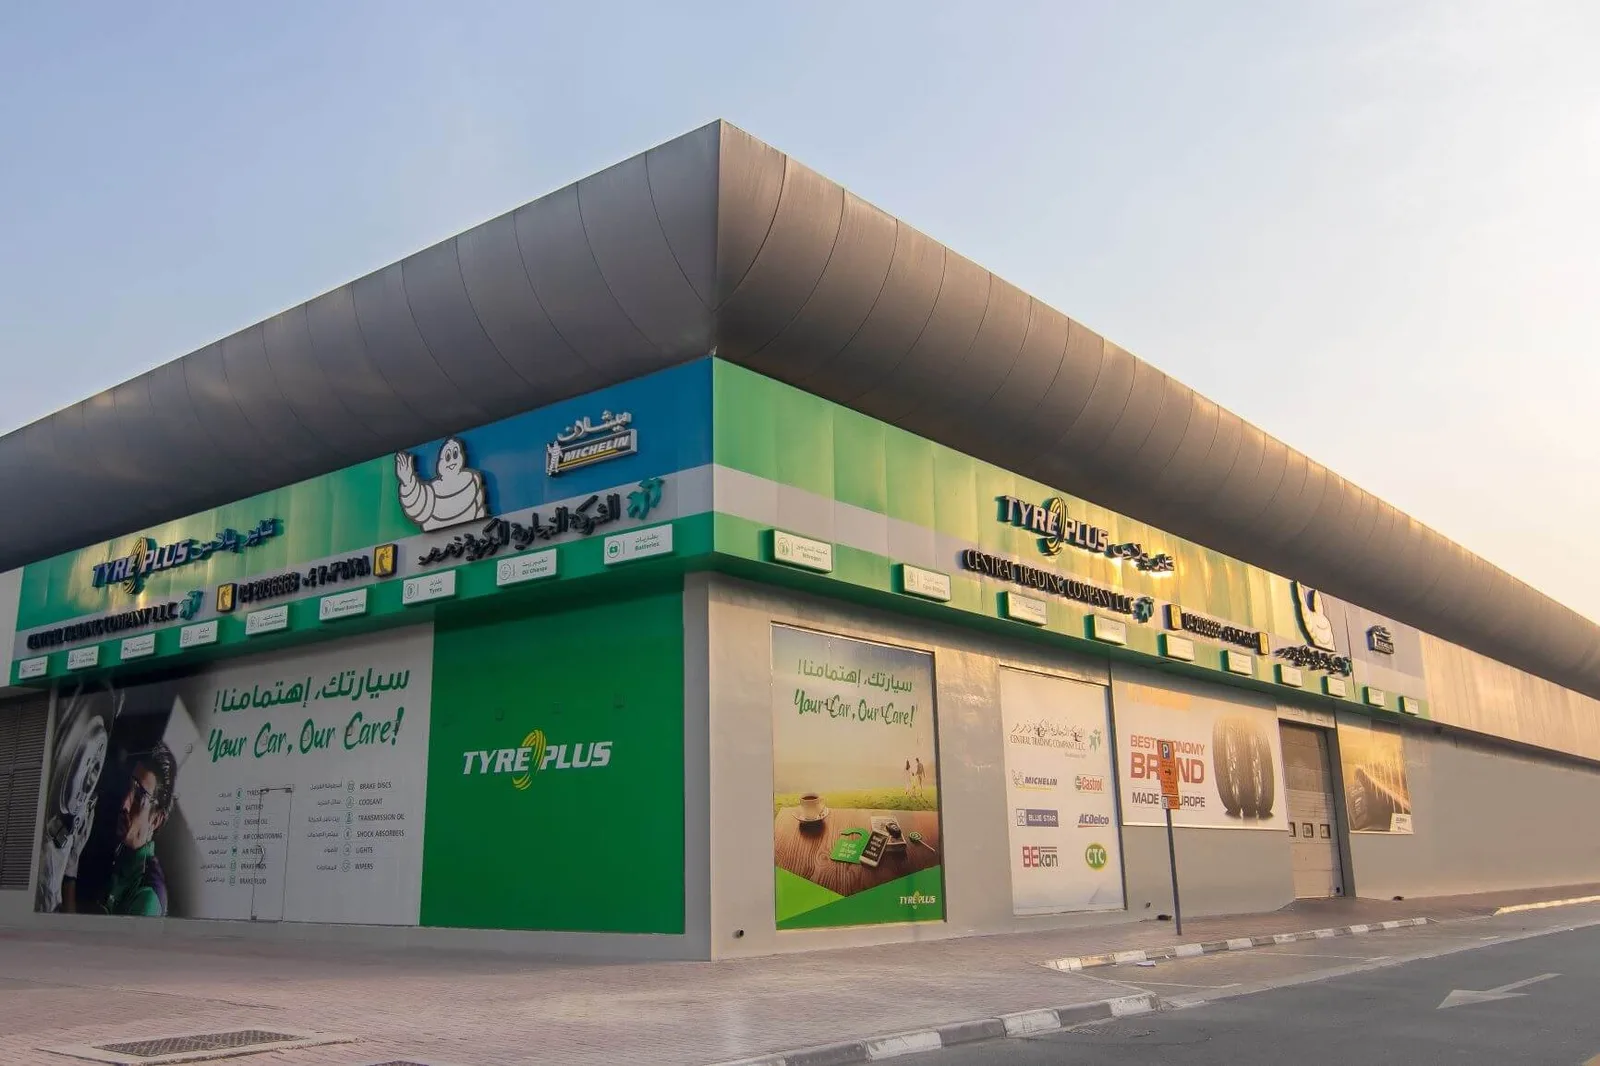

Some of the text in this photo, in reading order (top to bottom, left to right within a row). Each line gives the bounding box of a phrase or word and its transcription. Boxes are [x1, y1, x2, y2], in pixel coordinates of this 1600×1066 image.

[557, 409, 632, 441] ميشلان
[563, 435, 630, 462] MICHELIN
[963, 549, 1016, 580] CENTRAL
[1017, 563, 1064, 594] TRADING
[1064, 579, 1111, 608] COMPANY
[794, 688, 823, 714] Your
[858, 699, 879, 721] Our
[883, 702, 915, 728] Care!
[208, 707, 404, 762] Your Car, Our Care!
[1130, 734, 1205, 757] BEST NOMY
[1162, 743, 1169, 759] P
[1130, 752, 1205, 784] BRND
[1024, 776, 1058, 786] MICHELIN
[1081, 776, 1103, 791] Castrol
[1132, 792, 1159, 805] MADE
[1174, 794, 1205, 808] UROPE
[1028, 814, 1057, 822] BLUE STAR
[1078, 814, 1110, 825] ACDelco
[356, 846, 373, 854] LIGHTS
[1086, 848, 1105, 864] CTC
